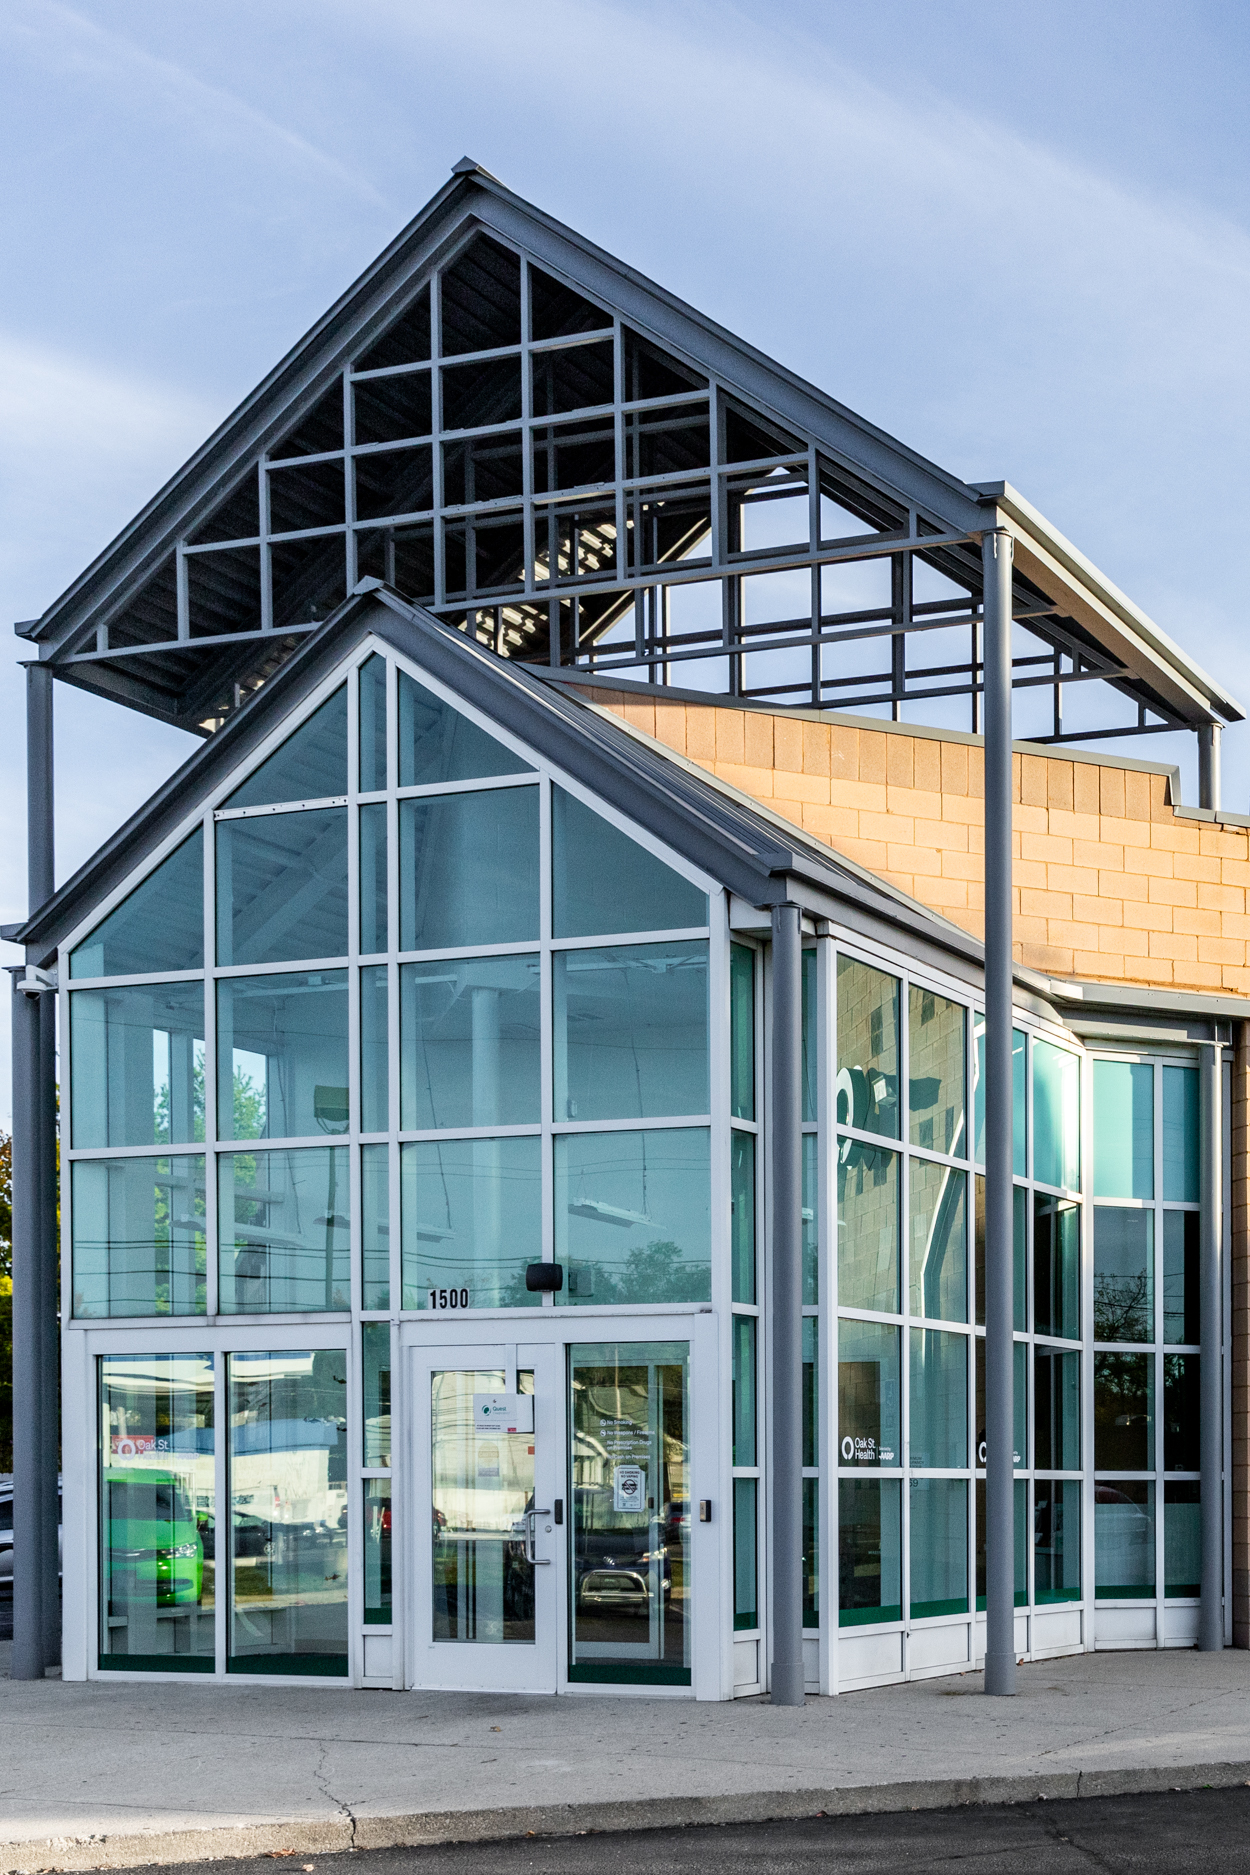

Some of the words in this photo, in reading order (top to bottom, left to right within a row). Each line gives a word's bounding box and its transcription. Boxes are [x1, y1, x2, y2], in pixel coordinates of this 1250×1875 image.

[430, 1288, 469, 1309] 1500
[137, 1439, 156, 1450] Oak
[854, 1437, 867, 1448] Oak
[854, 1448, 875, 1460] Health
